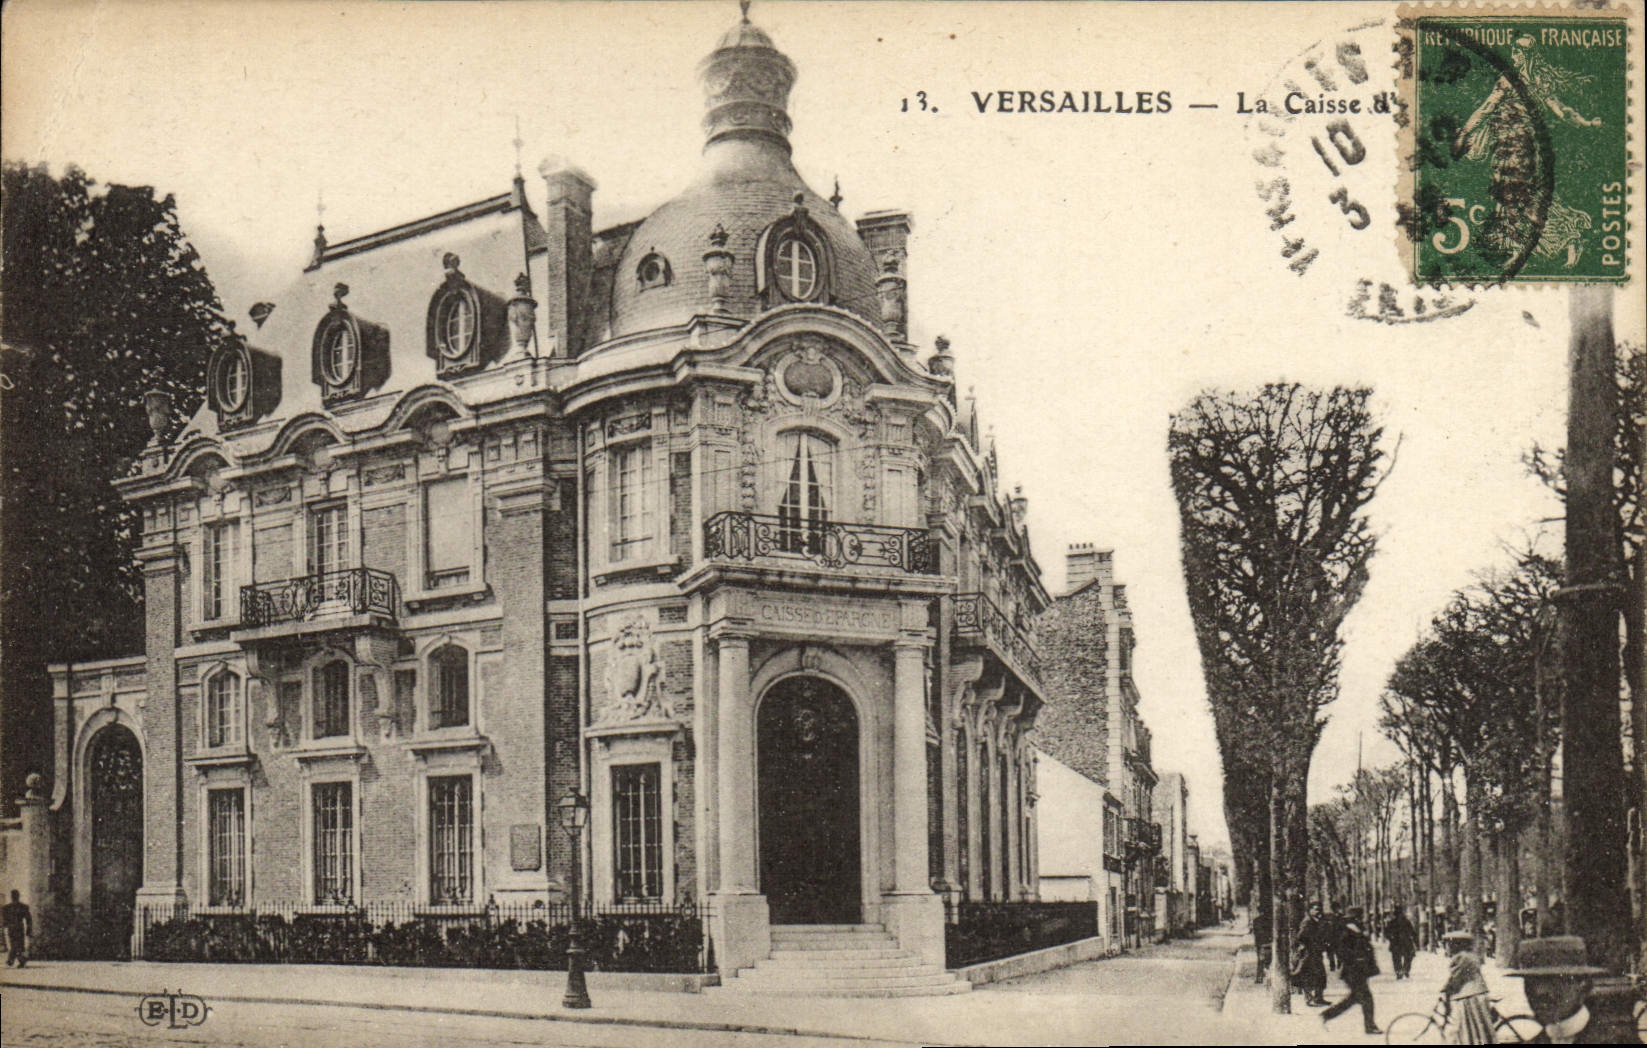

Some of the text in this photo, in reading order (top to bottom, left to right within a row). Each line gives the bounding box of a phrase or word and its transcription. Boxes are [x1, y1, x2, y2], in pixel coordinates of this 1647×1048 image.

[1424, 28, 1624, 48] REBLIQUE FRANÇAISE
[1602, 181, 1622, 266] POSTES
